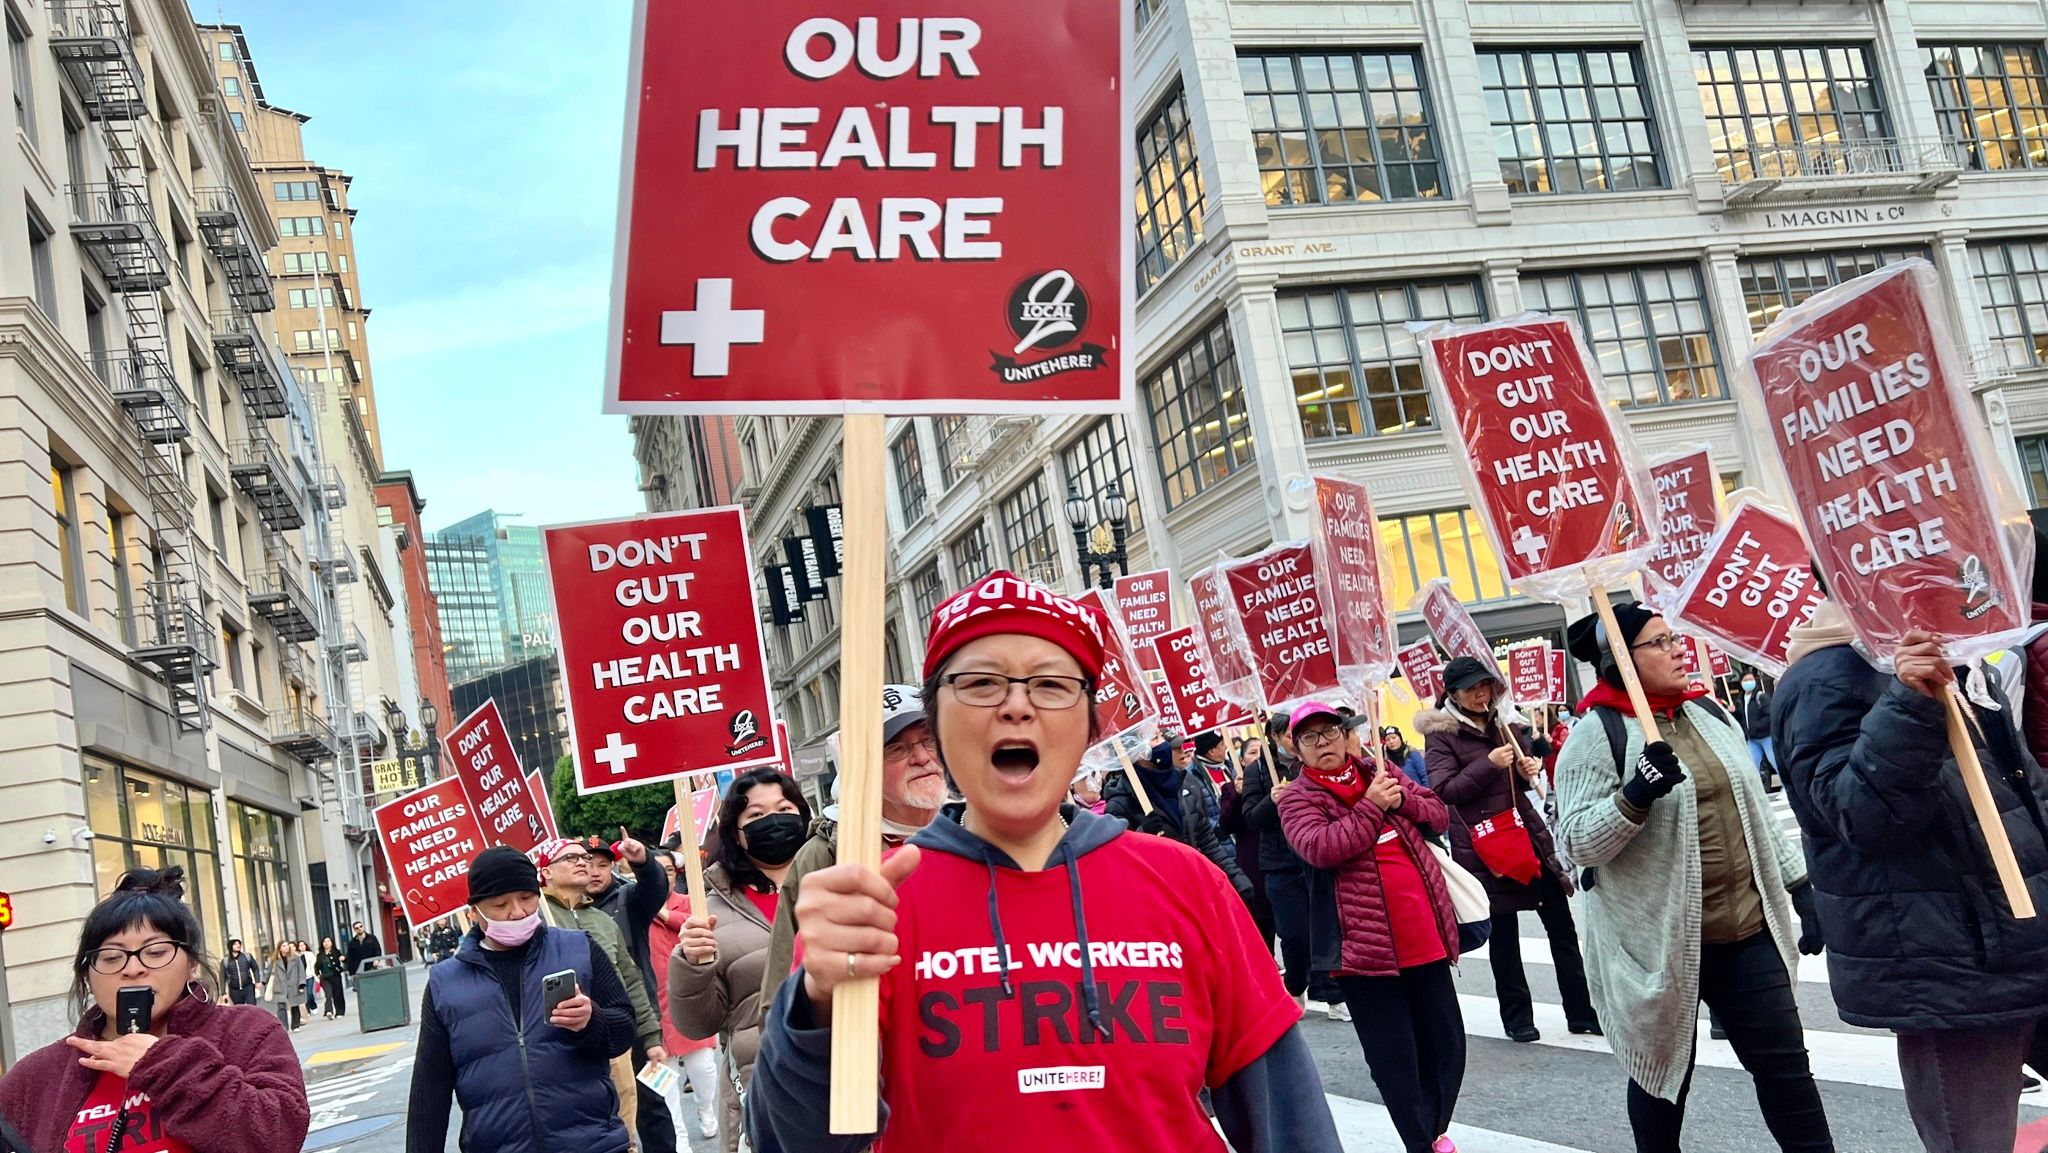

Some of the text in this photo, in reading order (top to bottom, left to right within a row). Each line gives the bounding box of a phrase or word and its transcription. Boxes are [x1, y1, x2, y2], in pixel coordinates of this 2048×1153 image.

[785, 16, 982, 80] OUR
[695, 106, 1063, 171] HEALTH
[749, 197, 1003, 262] CARE
[1781, 208, 1869, 228] MAGNIN
[1240, 245, 1295, 258] GRANT
[1021, 302, 1075, 320] LOCAL
[1467, 340, 1553, 378] DON'T
[1799, 322, 1874, 383] OUR
[1004, 355, 1092, 381] UNITEHERE!
[1496, 375, 1554, 408] GUT
[1781, 352, 1931, 447] FAMILIES
[1509, 410, 1572, 443] OUR
[1493, 440, 1607, 486] HEALTH
[1816, 418, 1915, 483] NEED
[1655, 467, 1693, 492] ON'T
[1335, 492, 1357, 513] OUR
[1527, 477, 1604, 517] CARE
[1816, 457, 1957, 536] HEALTH
[1327, 518, 1370, 540] FAMILIES
[1661, 514, 1693, 536] OUR
[589, 532, 707, 572] DON'T
[1339, 546, 1365, 566] NEED
[1850, 517, 1951, 577] CARE
[801, 539, 822, 588] MAYBAUM
[1257, 558, 1298, 581] OUR
[1663, 559, 1697, 581] CAR
[1705, 531, 1760, 608] DON'T
[616, 572, 695, 607] GUT
[1131, 579, 1153, 591] OUR
[1205, 579, 1217, 591] OU
[1243, 573, 1314, 610] FAMILIE
[1338, 574, 1374, 593] HEALTH
[1740, 553, 1780, 607] GUT
[1767, 567, 1810, 619] OUR
[1120, 592, 1166, 608] FAMILIES
[1264, 597, 1316, 625] NEED
[1348, 601, 1372, 620] CARE
[622, 611, 702, 645] OUR
[1129, 608, 1158, 621] NEED
[1211, 611, 1224, 624] NE
[1131, 637, 1153, 649] CAR
[1210, 626, 1229, 642] HEA
[1220, 640, 1240, 655] CAR
[1183, 650, 1201, 663] GU
[1279, 638, 1331, 665] CARE
[1515, 649, 1538, 659] DON'T
[1519, 658, 1536, 667] GUT
[592, 643, 740, 690] HEALTH
[1515, 673, 1544, 684] HEALTH
[1181, 679, 1211, 697] HEA
[1520, 682, 1540, 691] CARE
[624, 684, 723, 724] CARE
[1160, 715, 1179, 725] HEAL
[458, 719, 490, 756] DON'T
[471, 744, 494, 772] GUT
[480, 764, 504, 791] OUR
[403, 794, 441, 817] OUR
[479, 779, 522, 819] HEALTH
[389, 803, 467, 844] FAMILIES
[494, 803, 523, 833] CARE
[409, 826, 457, 855] NEED
[405, 838, 474, 876] HEALTH
[422, 859, 469, 888] CARE
[915, 941, 1182, 981] HOTEL WORKERS
[918, 980, 1190, 1060] STRIKE
[1023, 1071, 1101, 1087] UNITEHERE!
[77, 1104, 117, 1123] TEL
